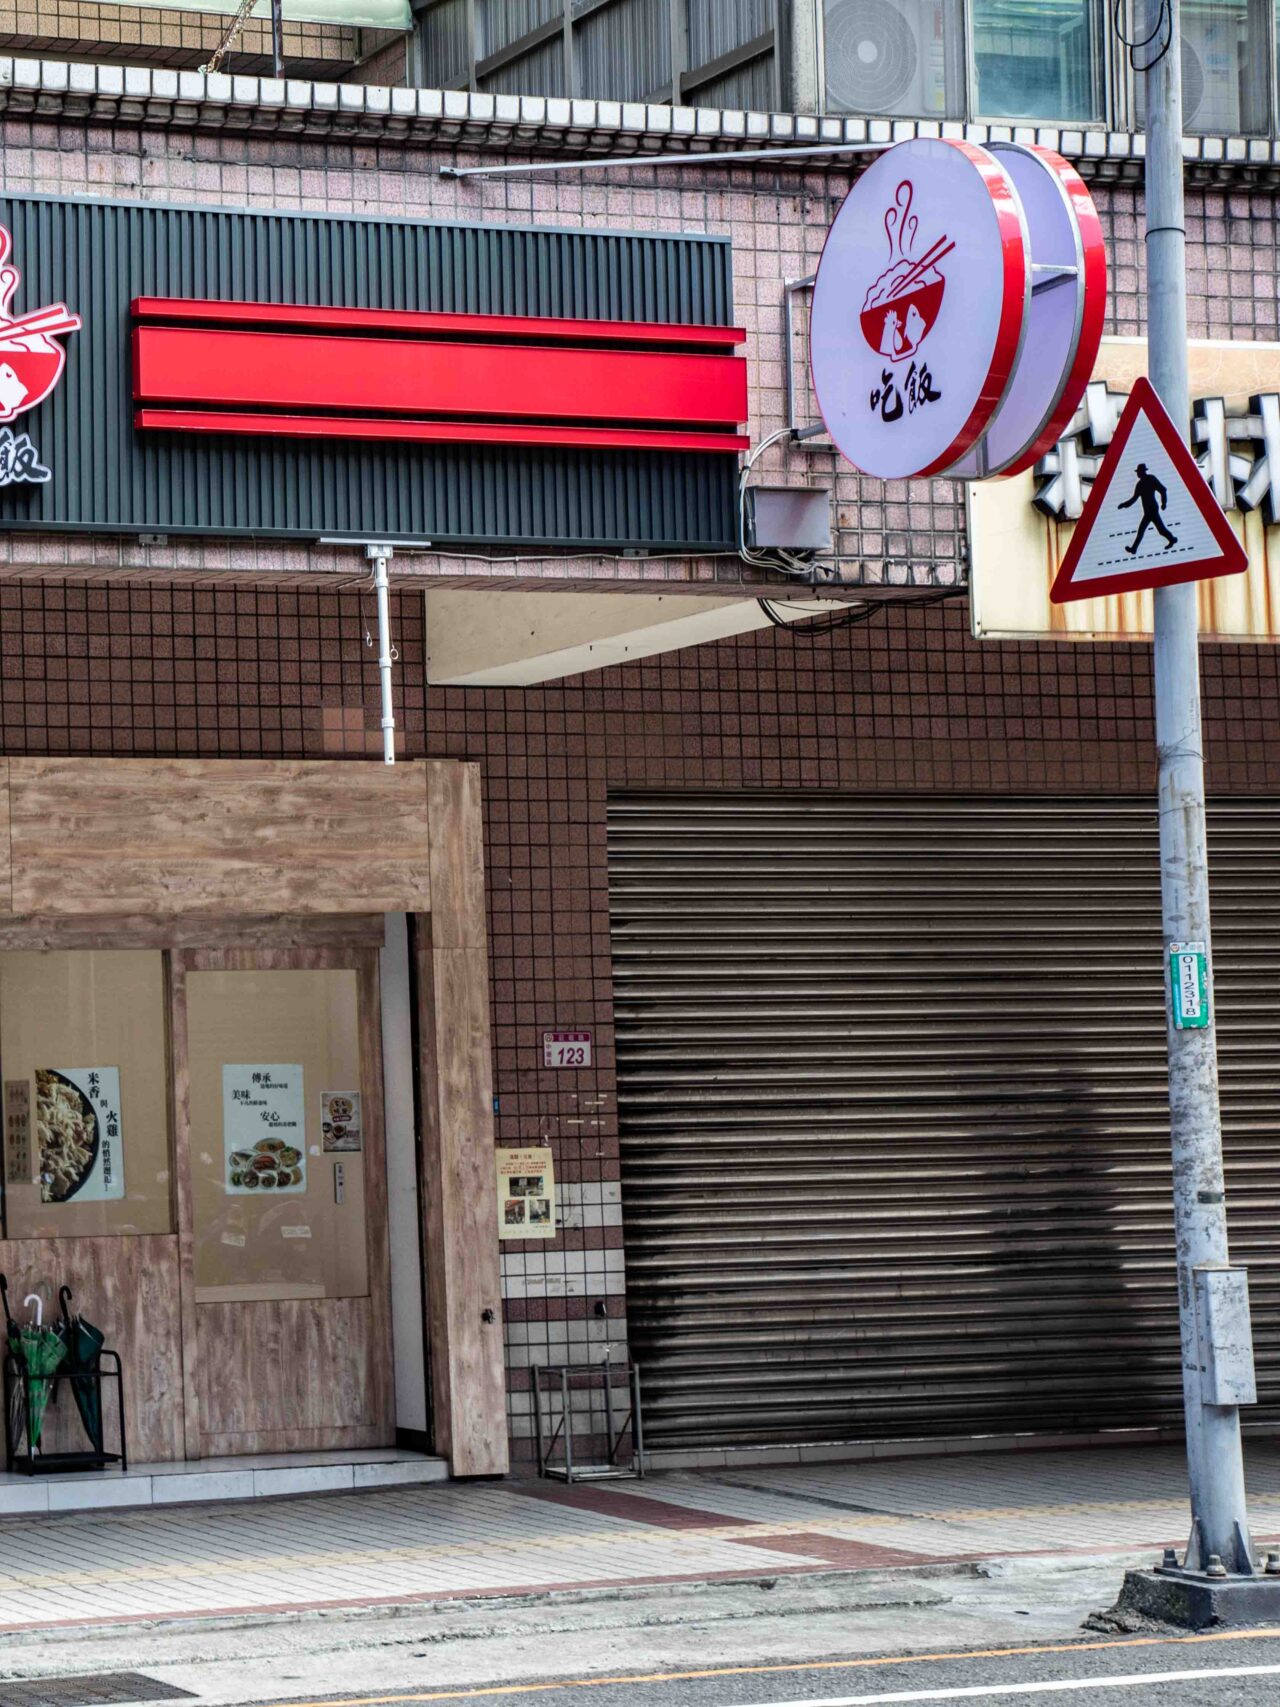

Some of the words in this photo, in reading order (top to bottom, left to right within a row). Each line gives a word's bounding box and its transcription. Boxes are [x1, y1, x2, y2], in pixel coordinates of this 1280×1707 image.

[870, 361, 941, 423] 吃飯
[1183, 955, 1196, 1016] 0112318
[558, 1047, 584, 1065] 123
[88, 1072, 100, 1099] 米香
[106, 1110, 118, 1137] 火雞
[232, 1089, 251, 1100] 美味
[260, 1111, 280, 1121] 安心
